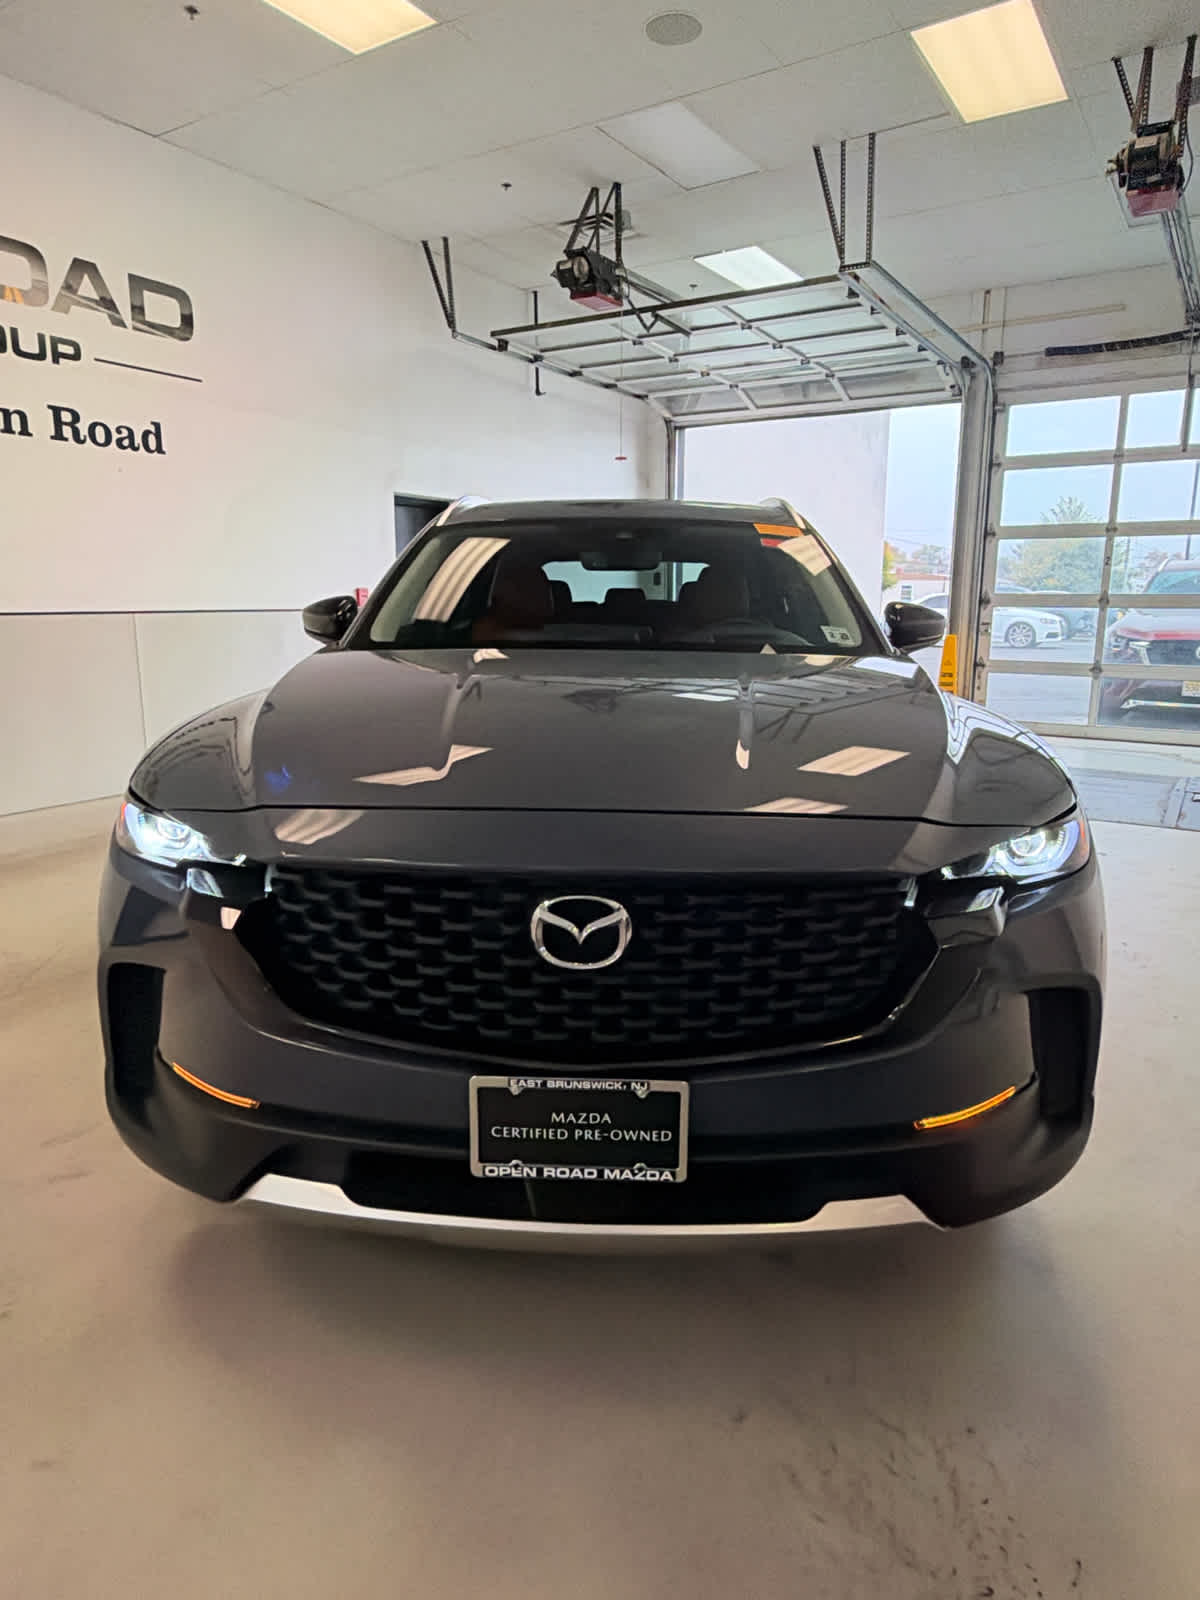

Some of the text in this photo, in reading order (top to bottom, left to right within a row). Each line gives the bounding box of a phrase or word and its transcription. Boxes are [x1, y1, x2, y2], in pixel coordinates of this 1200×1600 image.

[0, 325, 82, 365] UP
[47, 404, 166, 455] Road
[510, 1079, 648, 1091] EAST BRUNSWICK, NJ
[551, 1112, 612, 1124] MAZDA
[491, 1126, 673, 1142] CERTIFIED PRE-OWNED
[484, 1166, 674, 1181] OPEN ROAD MAZDA
